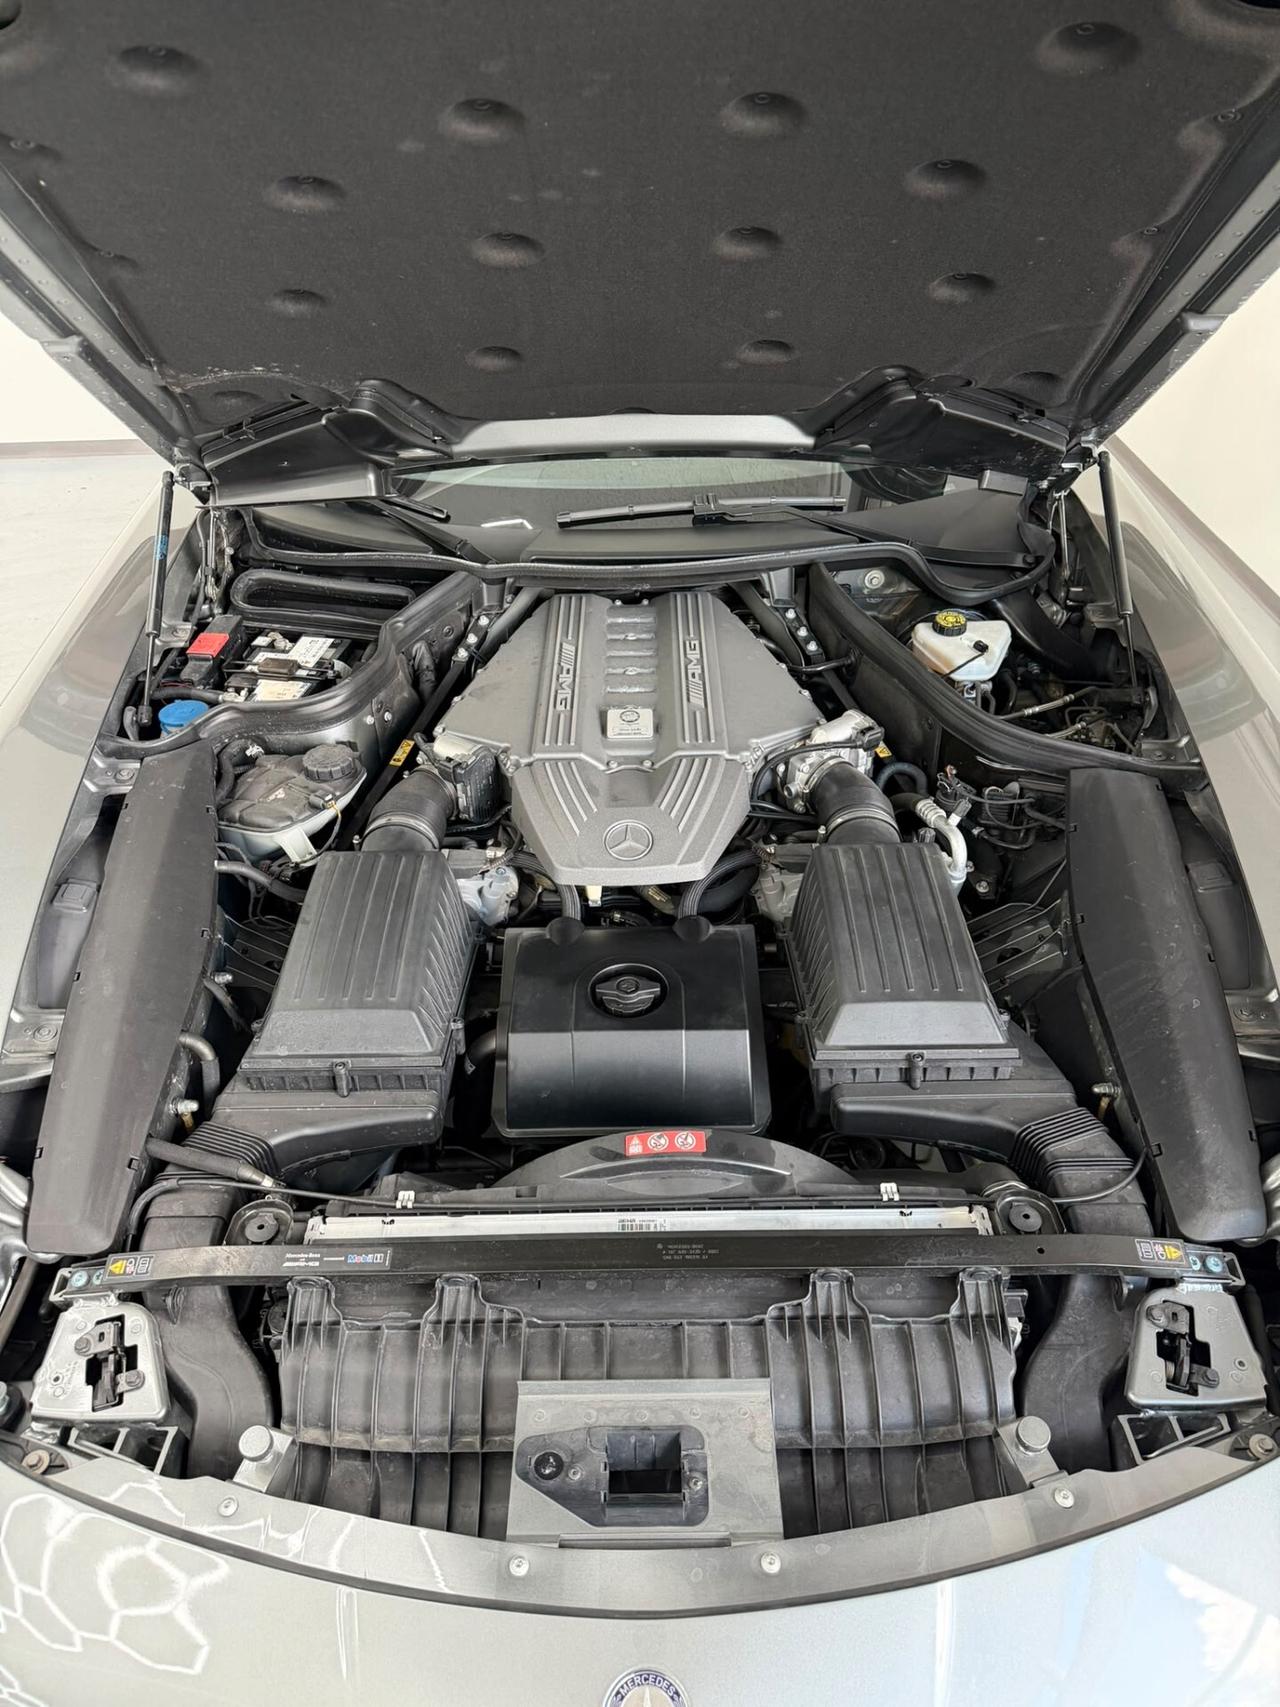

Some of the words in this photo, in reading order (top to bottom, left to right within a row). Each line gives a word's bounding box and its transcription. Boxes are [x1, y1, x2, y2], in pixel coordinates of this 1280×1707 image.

[685, 639, 702, 685] AMG
[555, 664, 575, 711] AMG
[619, 1674, 676, 1697] MERCEDES
